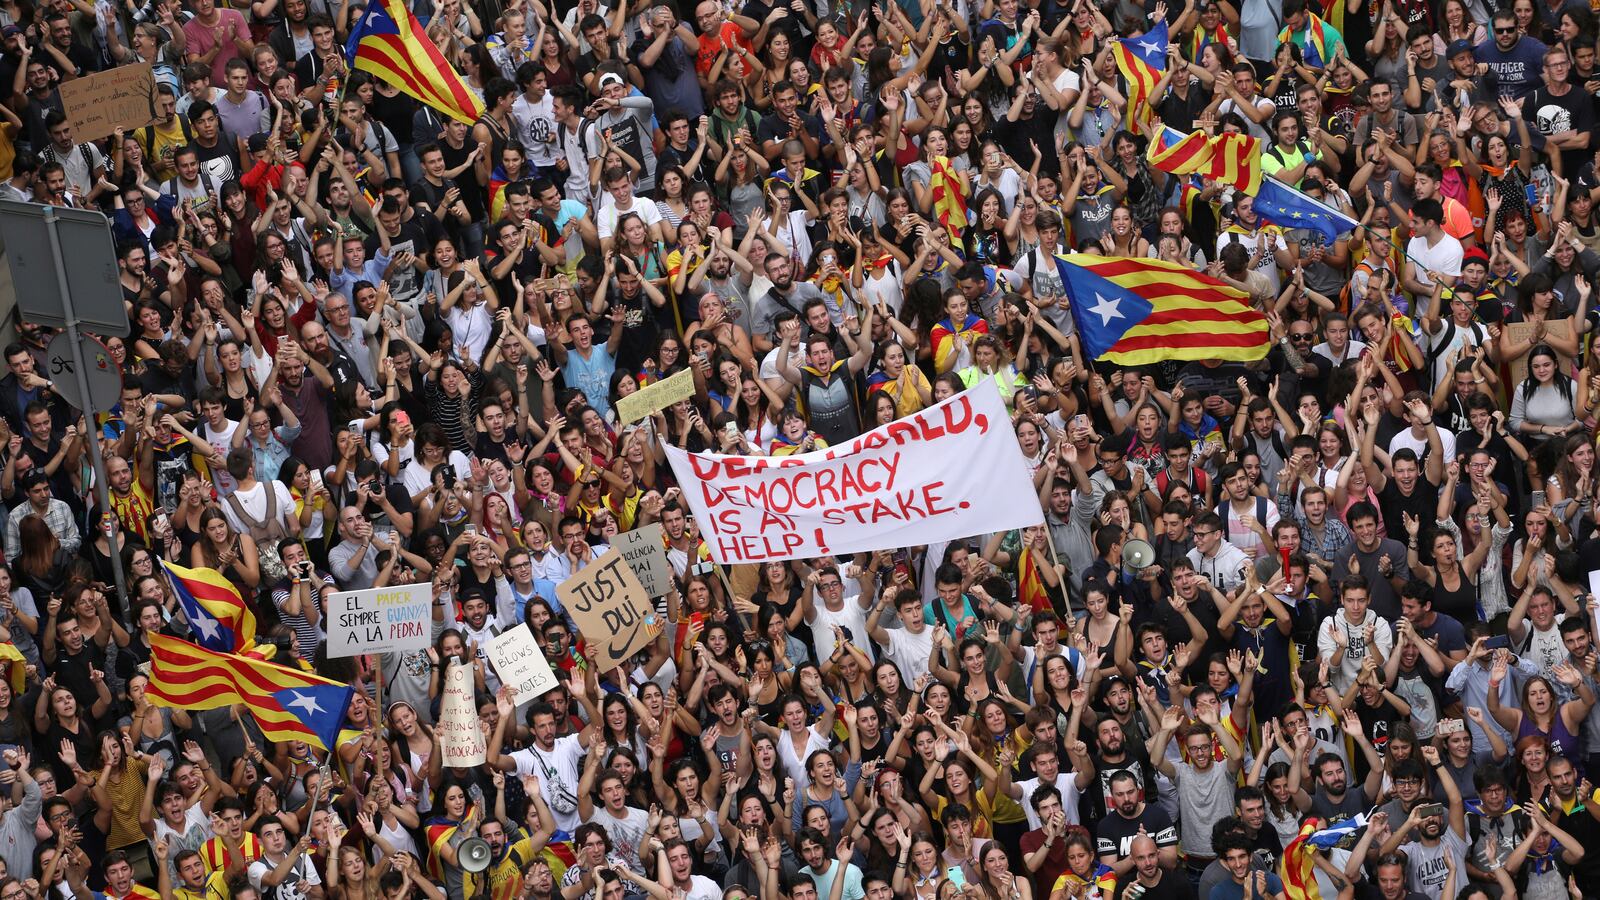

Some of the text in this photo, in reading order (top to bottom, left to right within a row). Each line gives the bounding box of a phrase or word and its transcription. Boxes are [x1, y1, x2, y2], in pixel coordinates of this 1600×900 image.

[687, 395, 988, 481] DE ORLD,
[701, 451, 900, 513] DEMOCRACY
[710, 481, 970, 535] IS AT STAKE.
[628, 532, 642, 543] LA
[621, 545, 657, 562] IOLÈNCIA
[571, 557, 627, 613] JUST
[646, 574, 654, 582] EL
[346, 592, 411, 611] EL PAPER
[340, 603, 429, 627] SEMPRE GUANYA
[347, 622, 424, 644] A LA PEDRA
[498, 645, 533, 668] BLOWS
[515, 673, 547, 693] VOTES
